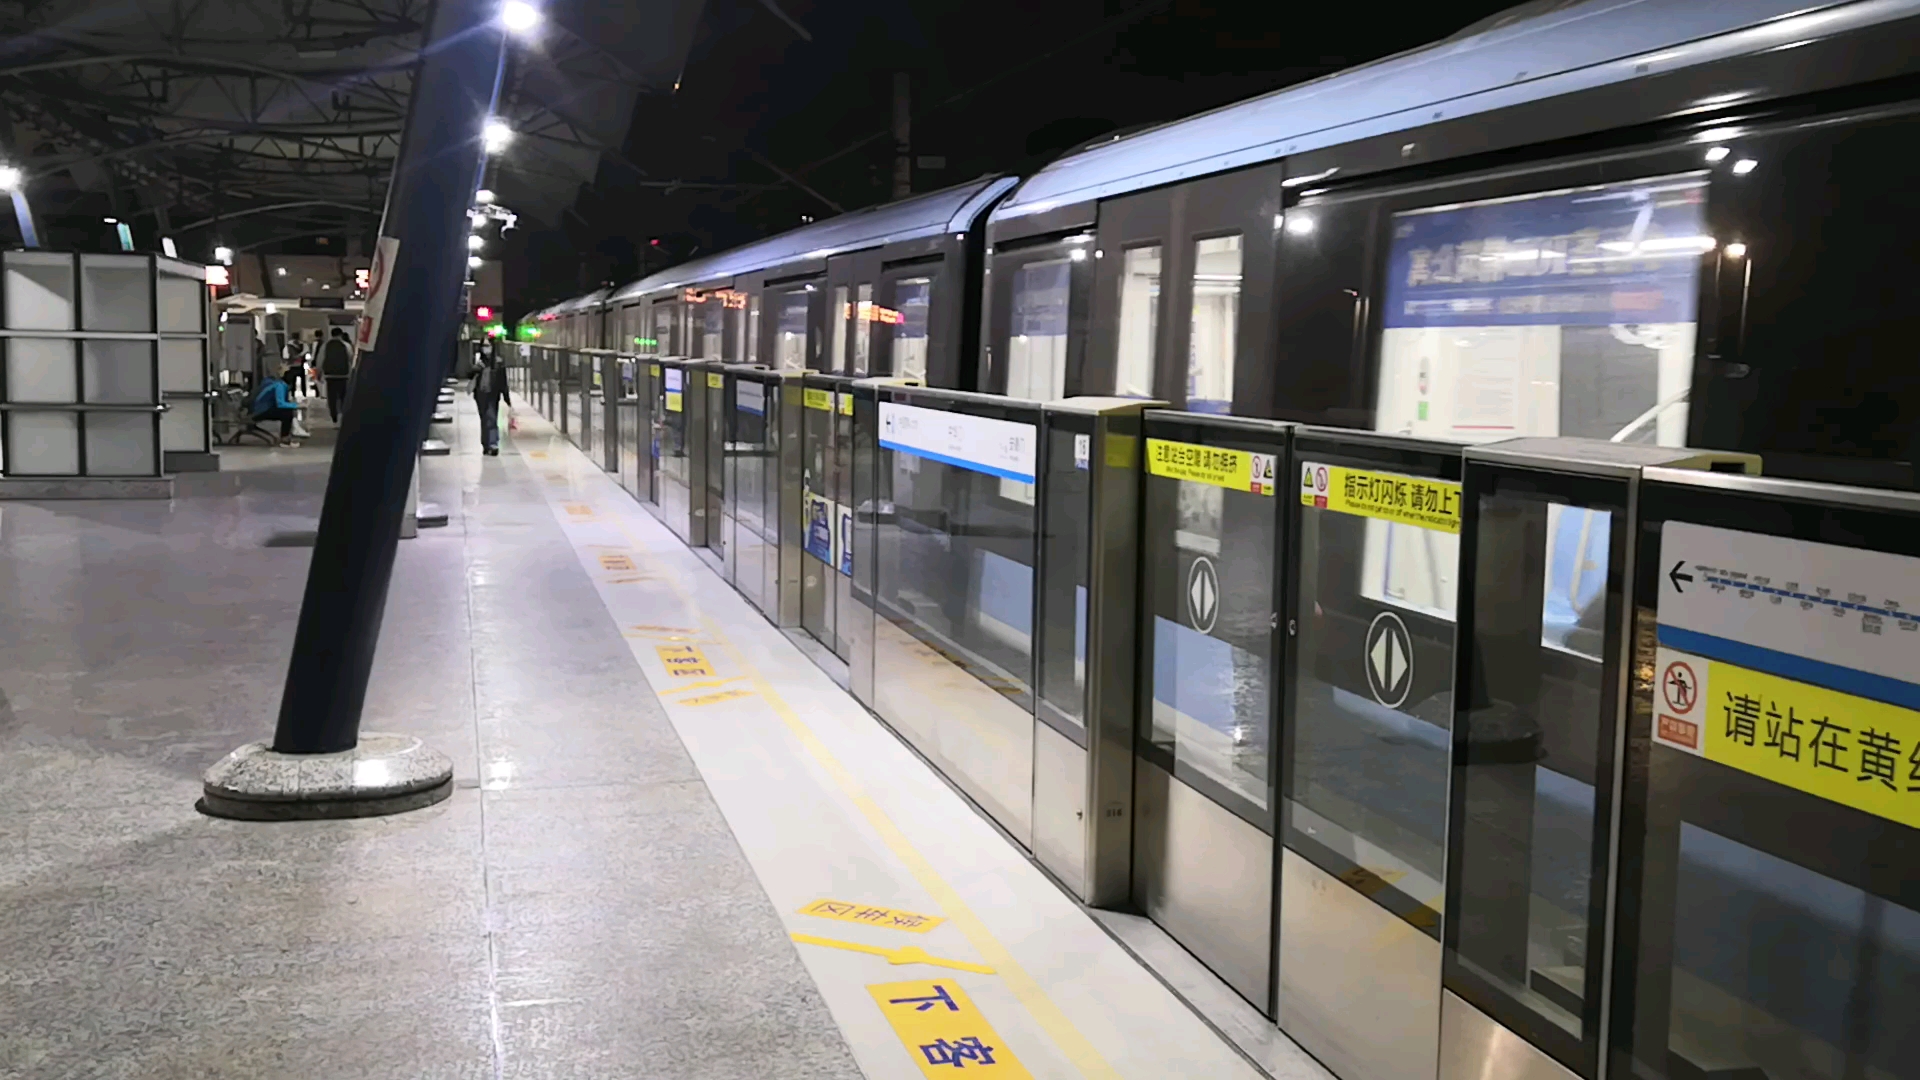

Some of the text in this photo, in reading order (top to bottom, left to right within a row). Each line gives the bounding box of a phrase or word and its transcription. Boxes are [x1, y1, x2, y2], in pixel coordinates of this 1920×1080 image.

[1344, 474, 1407, 507] 指示灯闪烁
[889, 985, 996, 1068] 下客
